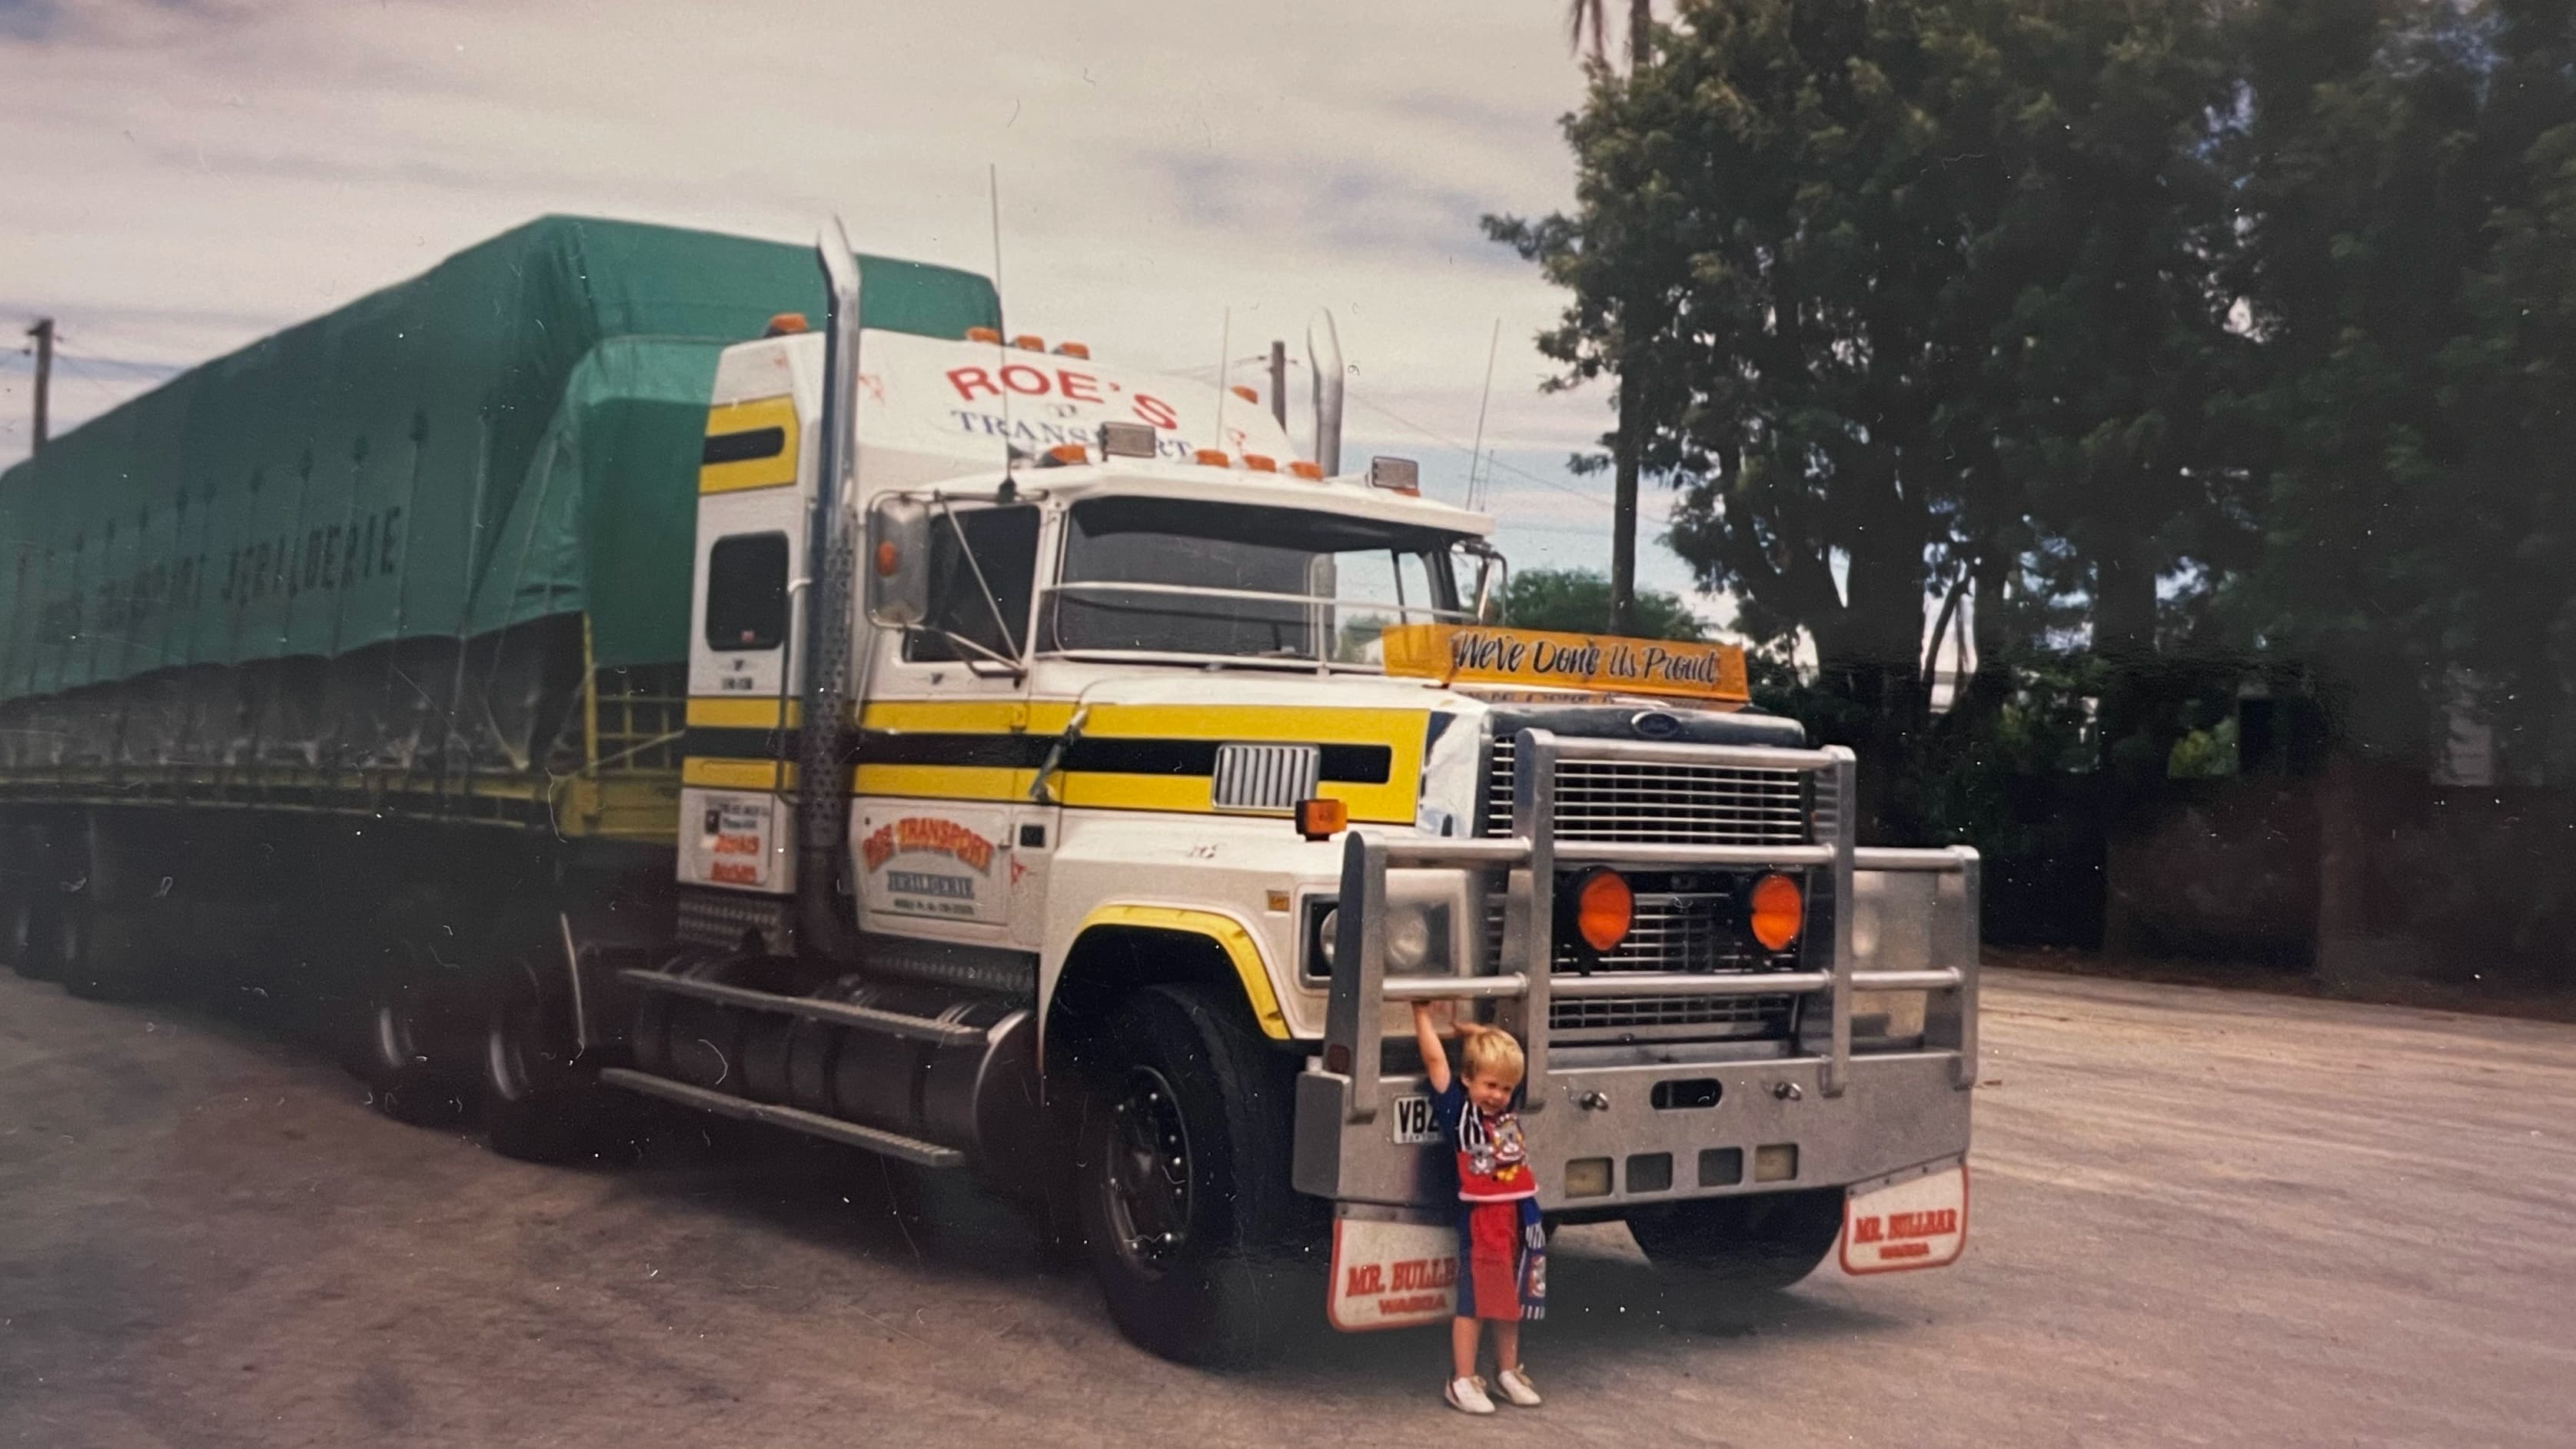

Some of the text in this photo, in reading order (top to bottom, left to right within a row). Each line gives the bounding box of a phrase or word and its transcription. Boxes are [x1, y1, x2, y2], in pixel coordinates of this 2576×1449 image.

[946, 364, 1178, 430] ROE'S
[951, 409, 1192, 457] TRANSRT
[1457, 632, 1719, 683] We've Done Us Proud
[1854, 1208, 1957, 1244] MR. BULLBAR
[1345, 1263, 1385, 1298] MR.
